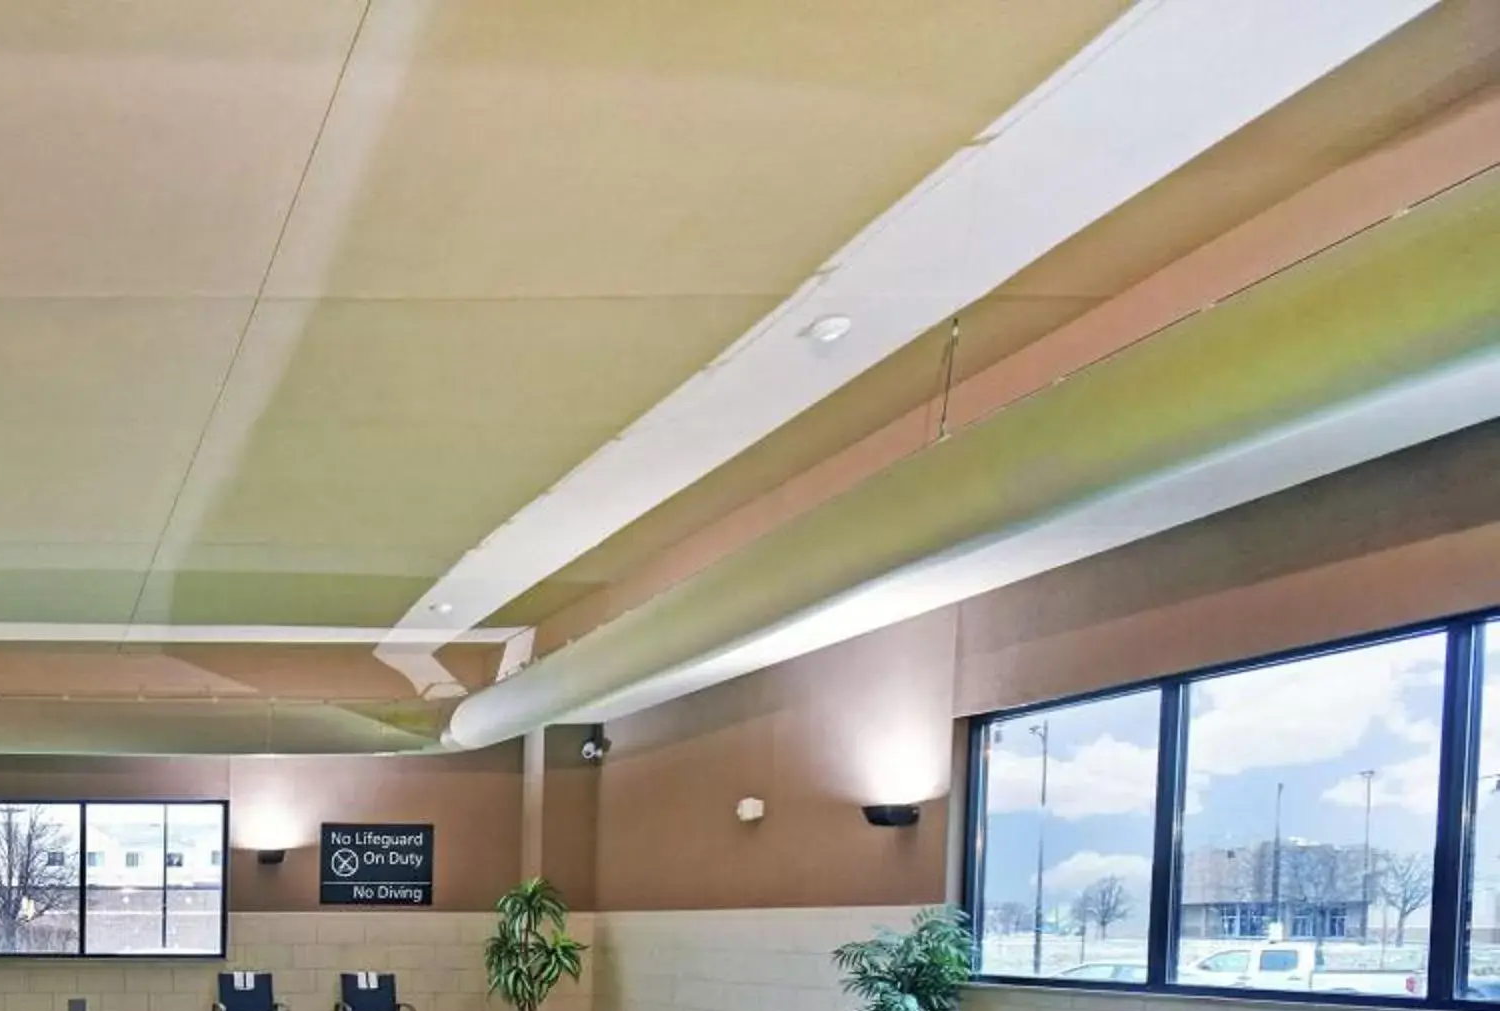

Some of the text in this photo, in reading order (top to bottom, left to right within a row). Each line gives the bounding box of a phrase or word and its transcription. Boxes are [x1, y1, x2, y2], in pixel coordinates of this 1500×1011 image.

[331, 832, 423, 849] No Lifeguard
[363, 851, 423, 868] On Duty
[353, 885, 423, 902] No Diving
